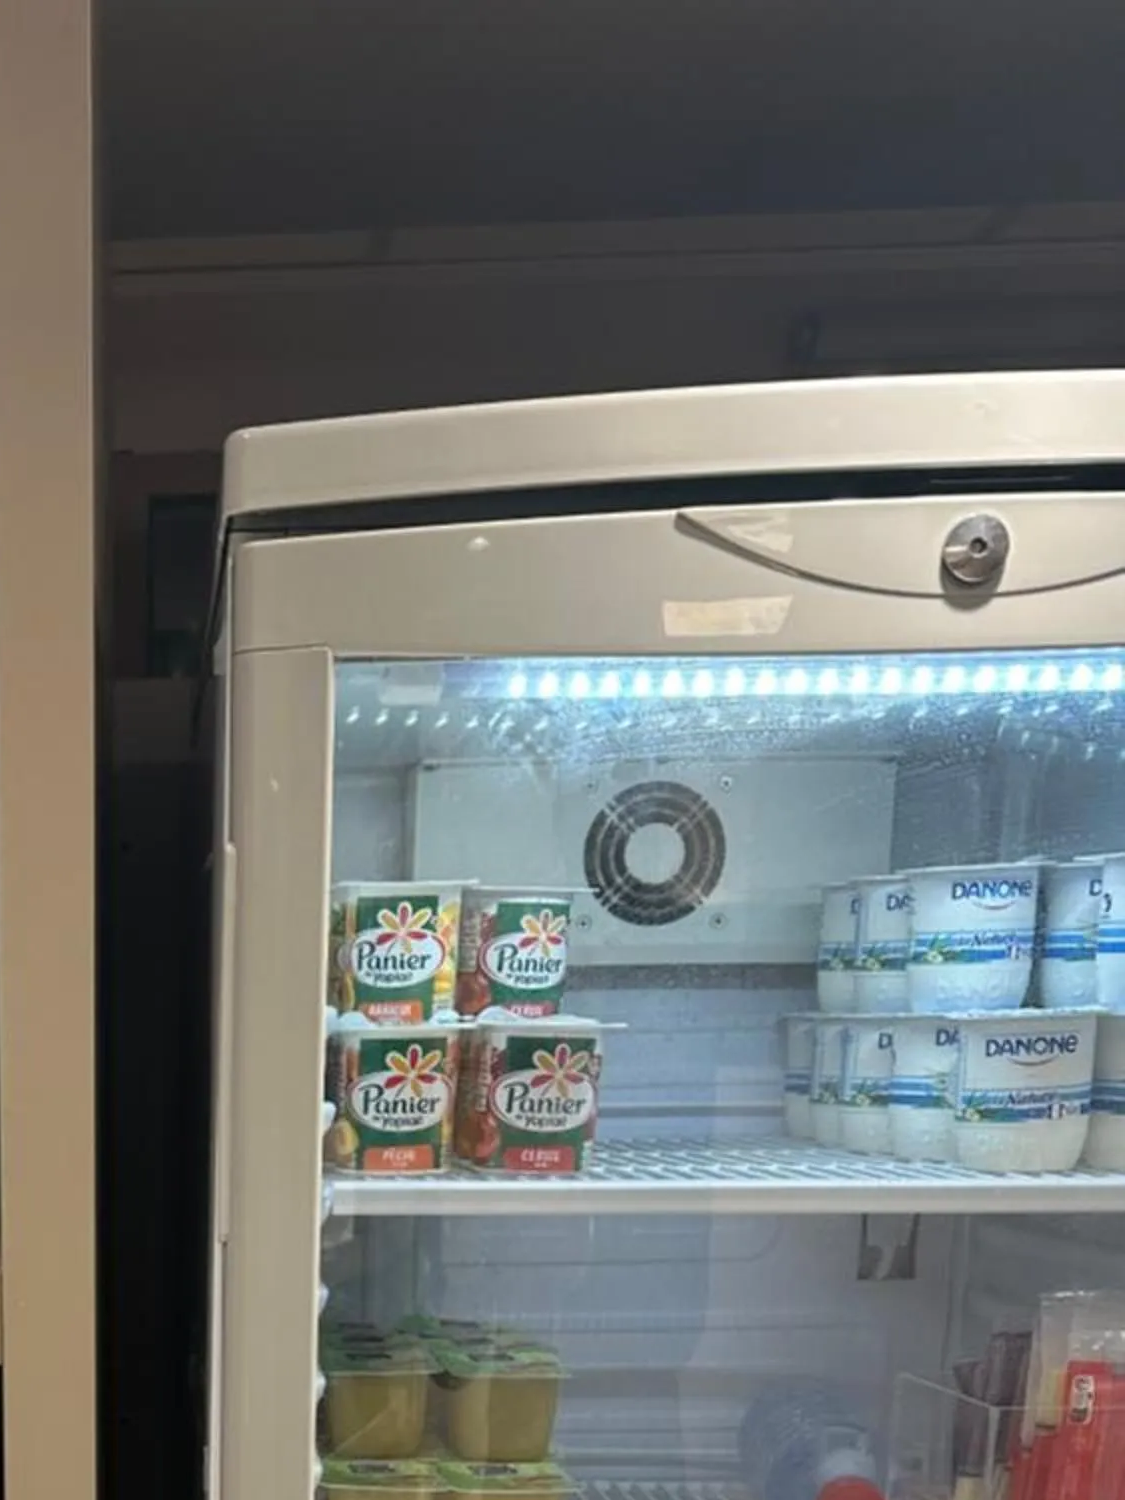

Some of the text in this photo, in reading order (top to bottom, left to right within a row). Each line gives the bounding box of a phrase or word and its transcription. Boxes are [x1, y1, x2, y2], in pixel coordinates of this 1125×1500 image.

[356, 940, 432, 971] Panier
[494, 944, 563, 973] Panier
[360, 1083, 441, 1115] Panier
[503, 1082, 586, 1113] Panier
